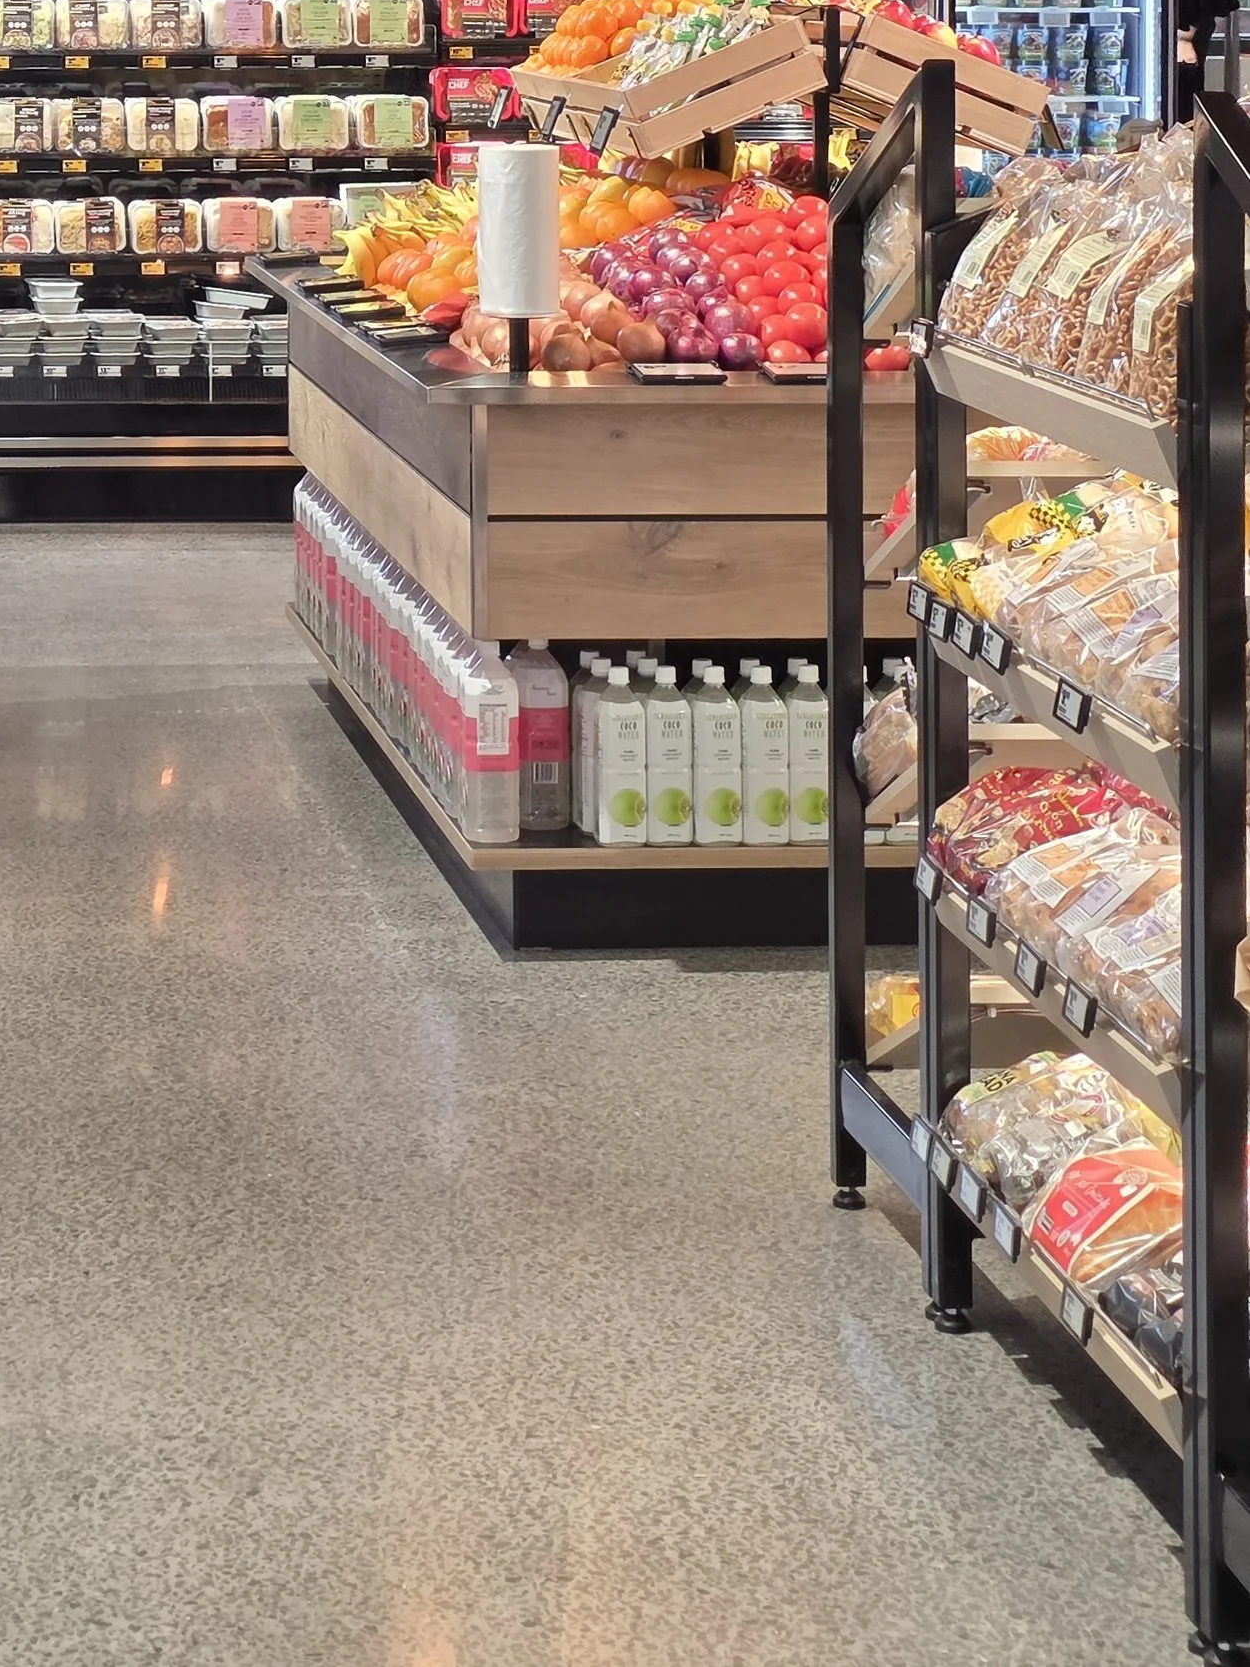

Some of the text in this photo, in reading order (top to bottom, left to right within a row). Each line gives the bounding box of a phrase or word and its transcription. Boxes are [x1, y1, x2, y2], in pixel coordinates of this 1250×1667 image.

[619, 721, 638, 731] COCO
[662, 719, 681, 730] COCO
[714, 721, 733, 731] COCO
[765, 719, 784, 730] COCO
[805, 720, 823, 731] COCO
